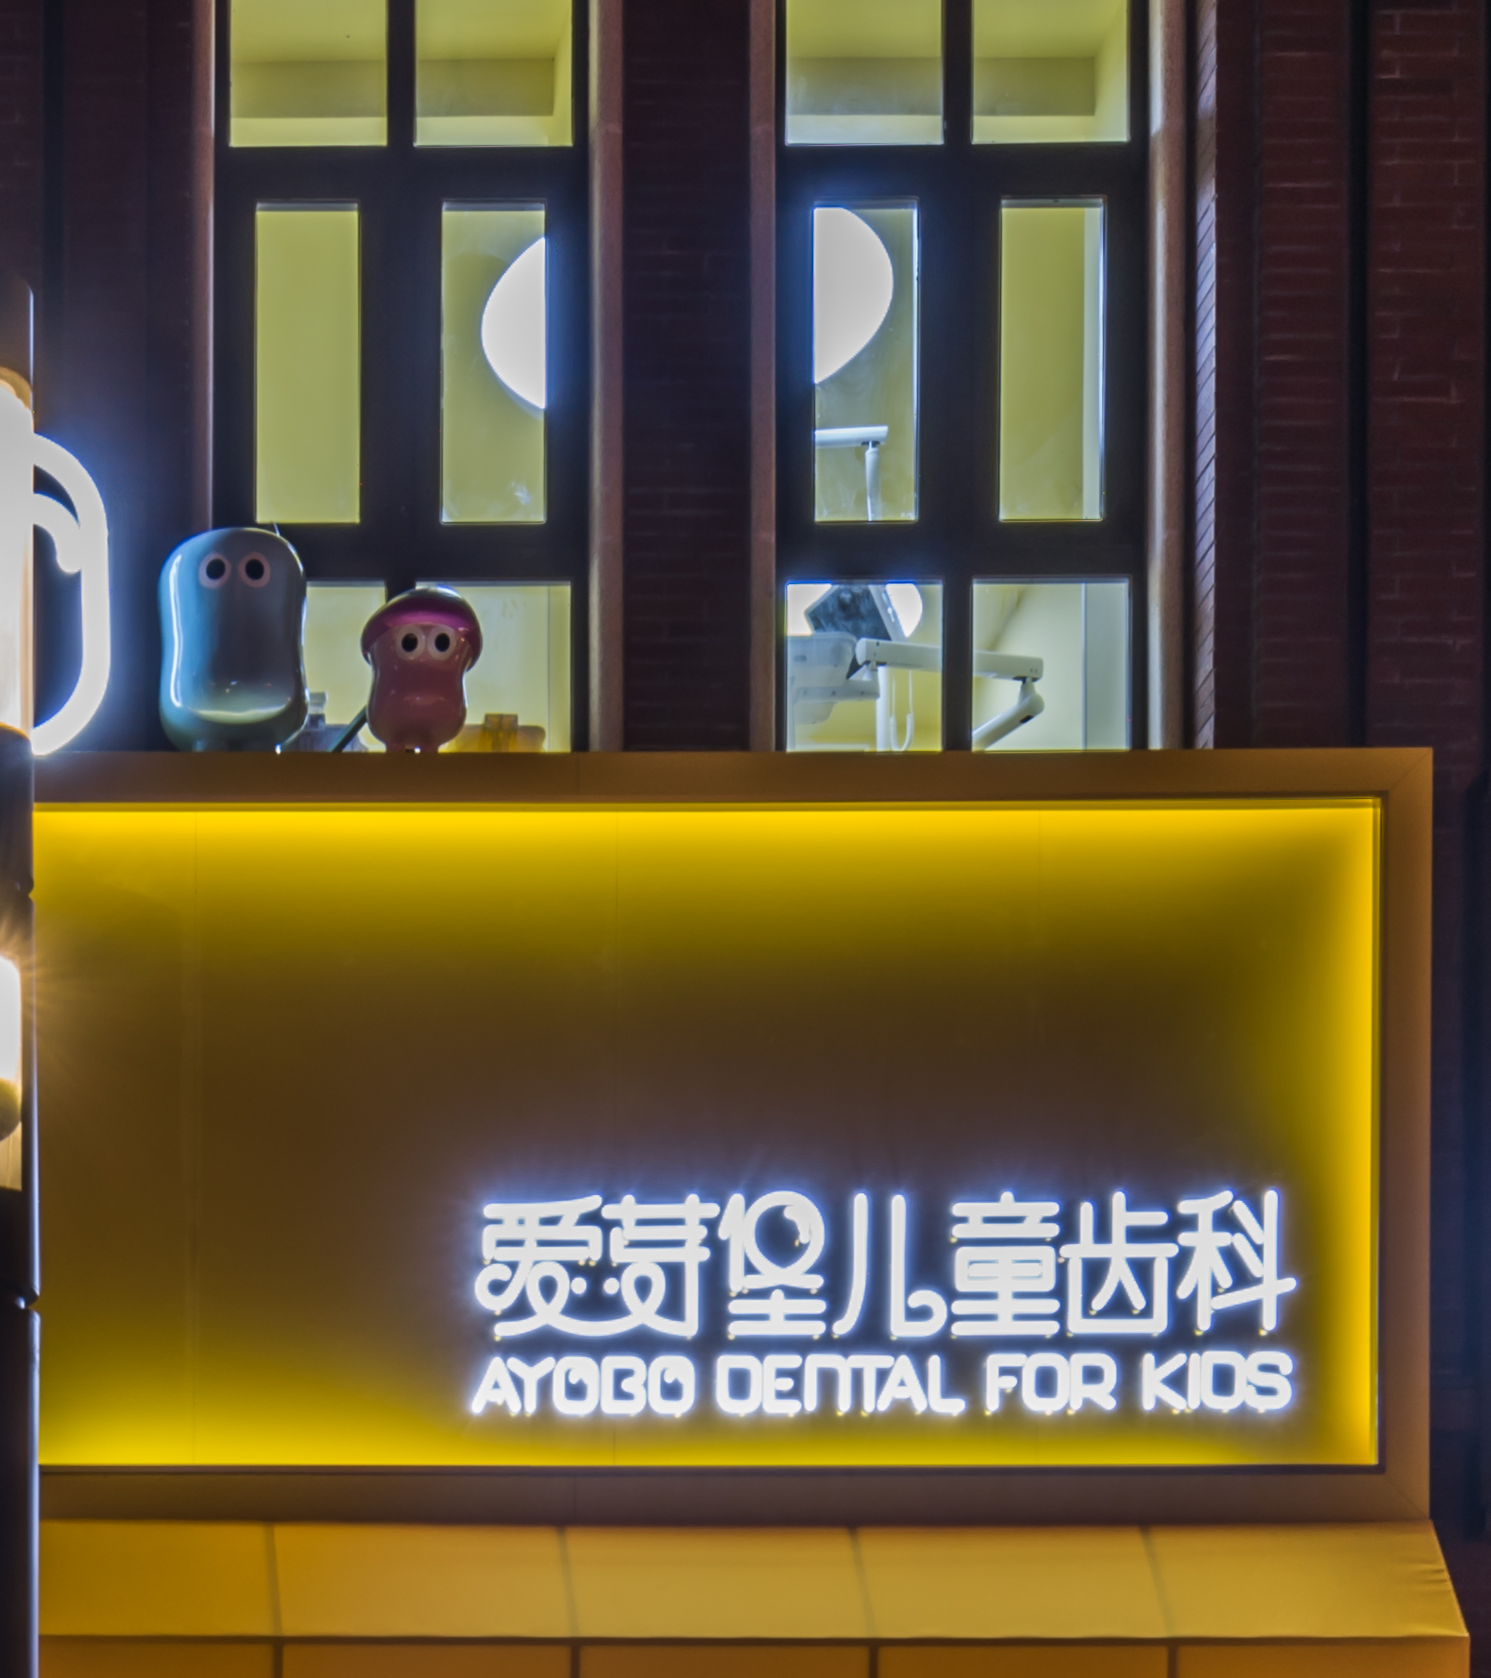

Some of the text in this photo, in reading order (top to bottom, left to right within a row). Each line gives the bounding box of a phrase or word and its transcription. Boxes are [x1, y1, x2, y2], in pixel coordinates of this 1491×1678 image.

[473, 1190, 1296, 1340] 爱芽堡儿童齿科
[471, 1351, 1294, 1416] AYOBO DENTAL FOR KIDS
